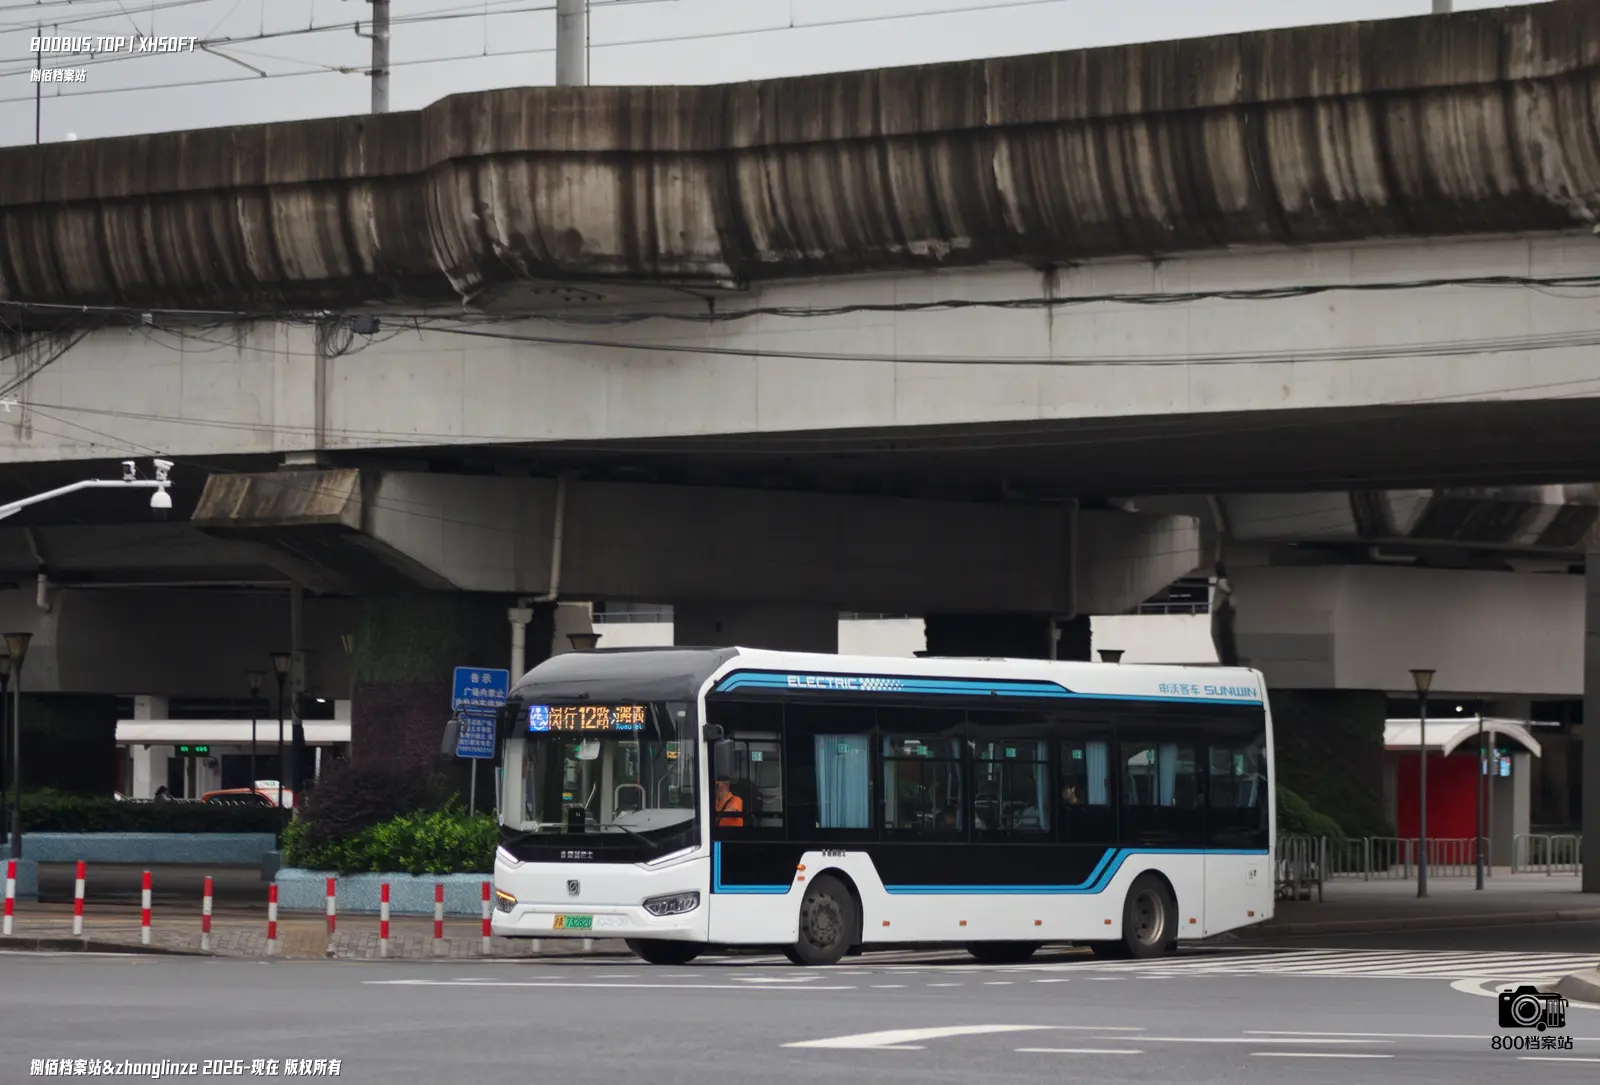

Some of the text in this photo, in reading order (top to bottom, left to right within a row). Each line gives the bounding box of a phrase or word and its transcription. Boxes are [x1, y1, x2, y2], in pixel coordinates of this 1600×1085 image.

[470, 672, 492, 684] 告示
[787, 675, 858, 689] ELECTRIC
[1158, 683, 1257, 697] 申沃客车 SUNWIN
[548, 706, 610, 730] 闵行12路
